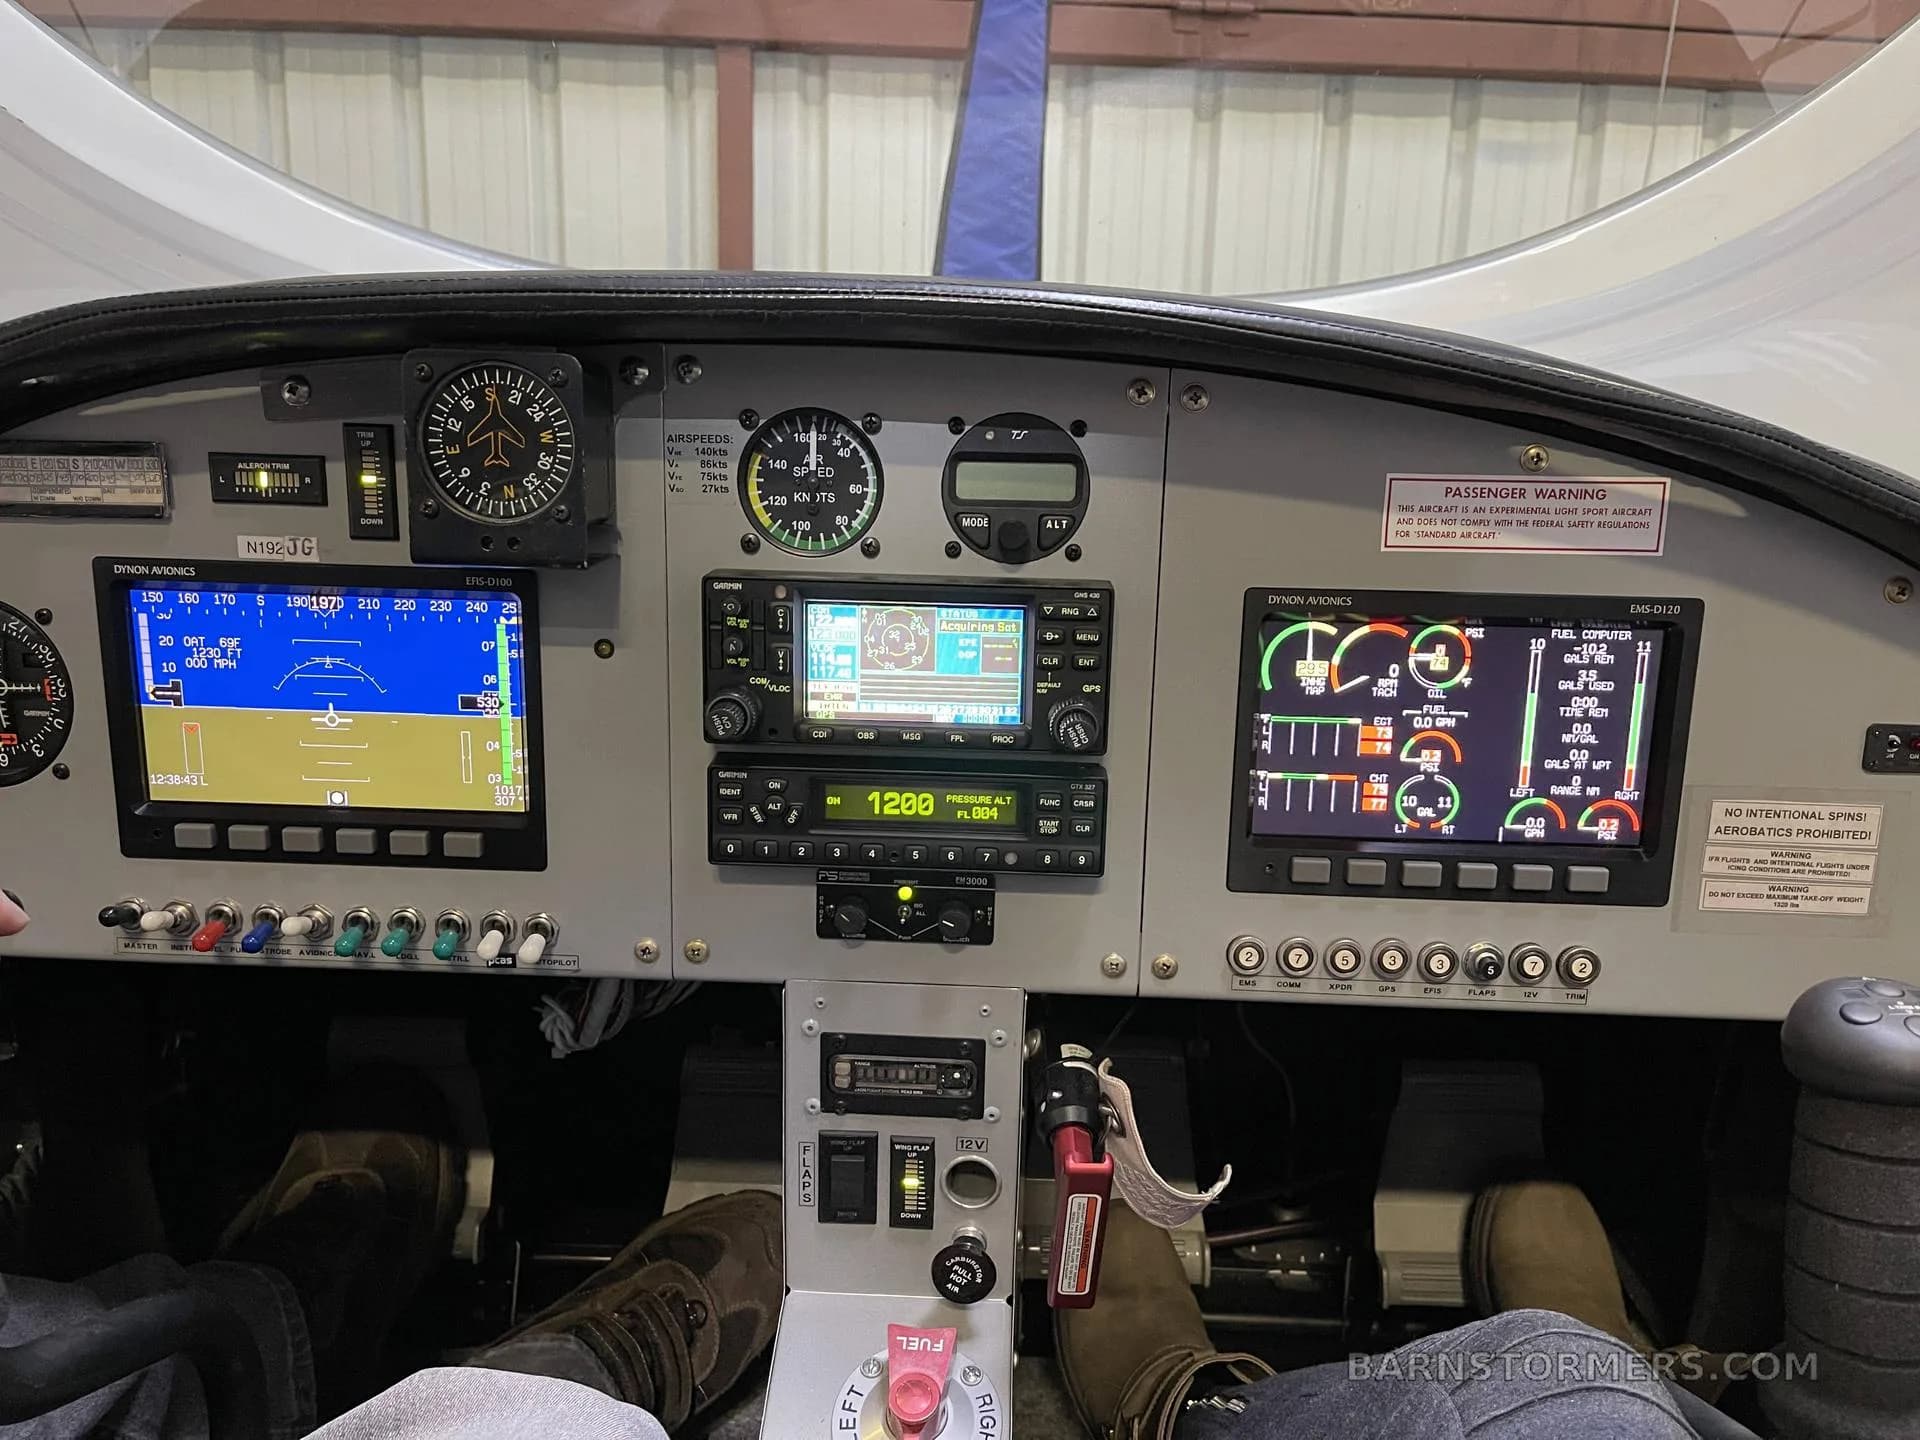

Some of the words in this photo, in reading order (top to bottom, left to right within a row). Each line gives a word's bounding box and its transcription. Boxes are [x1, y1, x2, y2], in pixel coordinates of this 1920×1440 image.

[667, 435, 733, 444] AIRSPEEDS:
[695, 447, 728, 456] 140kts
[701, 460, 728, 468] 86kts
[768, 460, 787, 469] 140
[701, 473, 728, 481] 75kts
[702, 485, 729, 493] 27kts
[850, 485, 862, 494] 60
[1444, 486, 1526, 499] PASSENGER
[1535, 488, 1607, 500] WARNING
[768, 496, 787, 505] 120
[1398, 505, 1415, 513] THIS
[1418, 505, 1458, 514] AIRCRAFT
[1462, 506, 1469, 514] IS
[1473, 506, 1485, 514] AN
[1490, 506, 1551, 515] EXPERIMENTAL
[1555, 508, 1578, 516] LIGHT
[1582, 508, 1608, 516] SPORT
[1612, 508, 1652, 517] AIRCRAFT
[792, 521, 810, 530] 100
[836, 516, 848, 525] 80
[962, 518, 988, 527] MODE
[1397, 518, 1413, 526] AND
[1417, 518, 1437, 526] DOES
[1460, 519, 1490, 527] COMPLY
[1494, 519, 1512, 527] WITH
[1532, 520, 1564, 528] FEDERAL
[1568, 520, 1594, 528] SAFETY
[1597, 521, 1650, 529] REGULATIONS
[247, 538, 314, 555] N192JG
[114, 565, 148, 574] DYNON
[151, 566, 195, 576] AVIONICS
[466, 577, 512, 586] EFIS-D100
[142, 592, 163, 602] 150
[178, 593, 199, 603] 160
[214, 595, 235, 605] 170
[257, 596, 265, 606] S
[287, 597, 308, 607] 190
[312, 596, 336, 609] 197
[358, 599, 380, 610] 210
[394, 600, 416, 610] 220
[430, 601, 452, 612] 230
[466, 602, 487, 613] 240
[1269, 595, 1304, 604] DYNON
[1307, 597, 1352, 606] AVIONICS
[1630, 604, 1680, 615] EMS-D120
[941, 621, 995, 632] Acquiring
[997, 622, 1017, 632] Sat
[1077, 633, 1099, 641] MENU
[1552, 629, 1576, 639] FUEL
[1582, 630, 1632, 640] COMPUTER
[183, 637, 205, 647] OAT
[220, 638, 240, 647] 69F
[193, 648, 220, 658] 1230
[228, 649, 242, 658] FT
[185, 658, 207, 668] 000
[214, 659, 236, 669] MPH
[1042, 657, 1058, 665] CLR
[1564, 655, 1590, 664] GALS
[1594, 655, 1614, 664] REM
[1559, 681, 1584, 690] GALS
[1589, 681, 1614, 690] USED
[1372, 688, 1397, 697] TACH
[1423, 706, 1447, 715] FUEL
[1560, 708, 1584, 717] TIME
[1589, 708, 1608, 717] REM
[1374, 717, 1392, 726] EGT
[813, 730, 827, 738] CDI
[903, 733, 920, 741] MSG
[1544, 760, 1570, 769] GALS
[1574, 761, 1588, 769] AT
[1593, 761, 1611, 770] WPT
[150, 774, 198, 786] 12:38:43
[1370, 774, 1388, 783] CHT
[1510, 788, 1535, 797] LEFT
[1551, 786, 1583, 795] RANGE
[1586, 787, 1600, 796] NM
[867, 792, 934, 816] 1200
[946, 795, 992, 804] PRESSURE
[995, 796, 1012, 805] ALT
[750, 806, 763, 824] STBY
[787, 810, 799, 824] OFF
[957, 811, 971, 819] FL
[972, 807, 998, 820] 004
[1417, 807, 1436, 817] GAL
[1725, 808, 1742, 817] NO
[1746, 809, 1824, 820] INTENTIONAL
[1828, 812, 1867, 821] SPINS!
[1525, 828, 1545, 837] GPH
[1715, 826, 1792, 837] AEROBATICS
[1796, 829, 1871, 840] PROHIBITED!
[1770, 851, 1811, 859] WARNING
[1768, 885, 1809, 893] WARNING
[124, 942, 158, 950] MASTER
[1239, 979, 1257, 987] EMS
[1329, 983, 1353, 991] XPDR
[1468, 989, 1496, 997] FLAPS
[1566, 992, 1585, 1001] TRIM
[959, 1140, 984, 1149] 12V
[802, 1146, 812, 1202] FLAPS
[945, 1256, 983, 1283] CARBURETOR
[953, 1265, 972, 1280] PULL
[949, 1273, 968, 1286] HOT
[946, 1283, 960, 1293] AIR
[896, 1336, 944, 1352] FUEL
